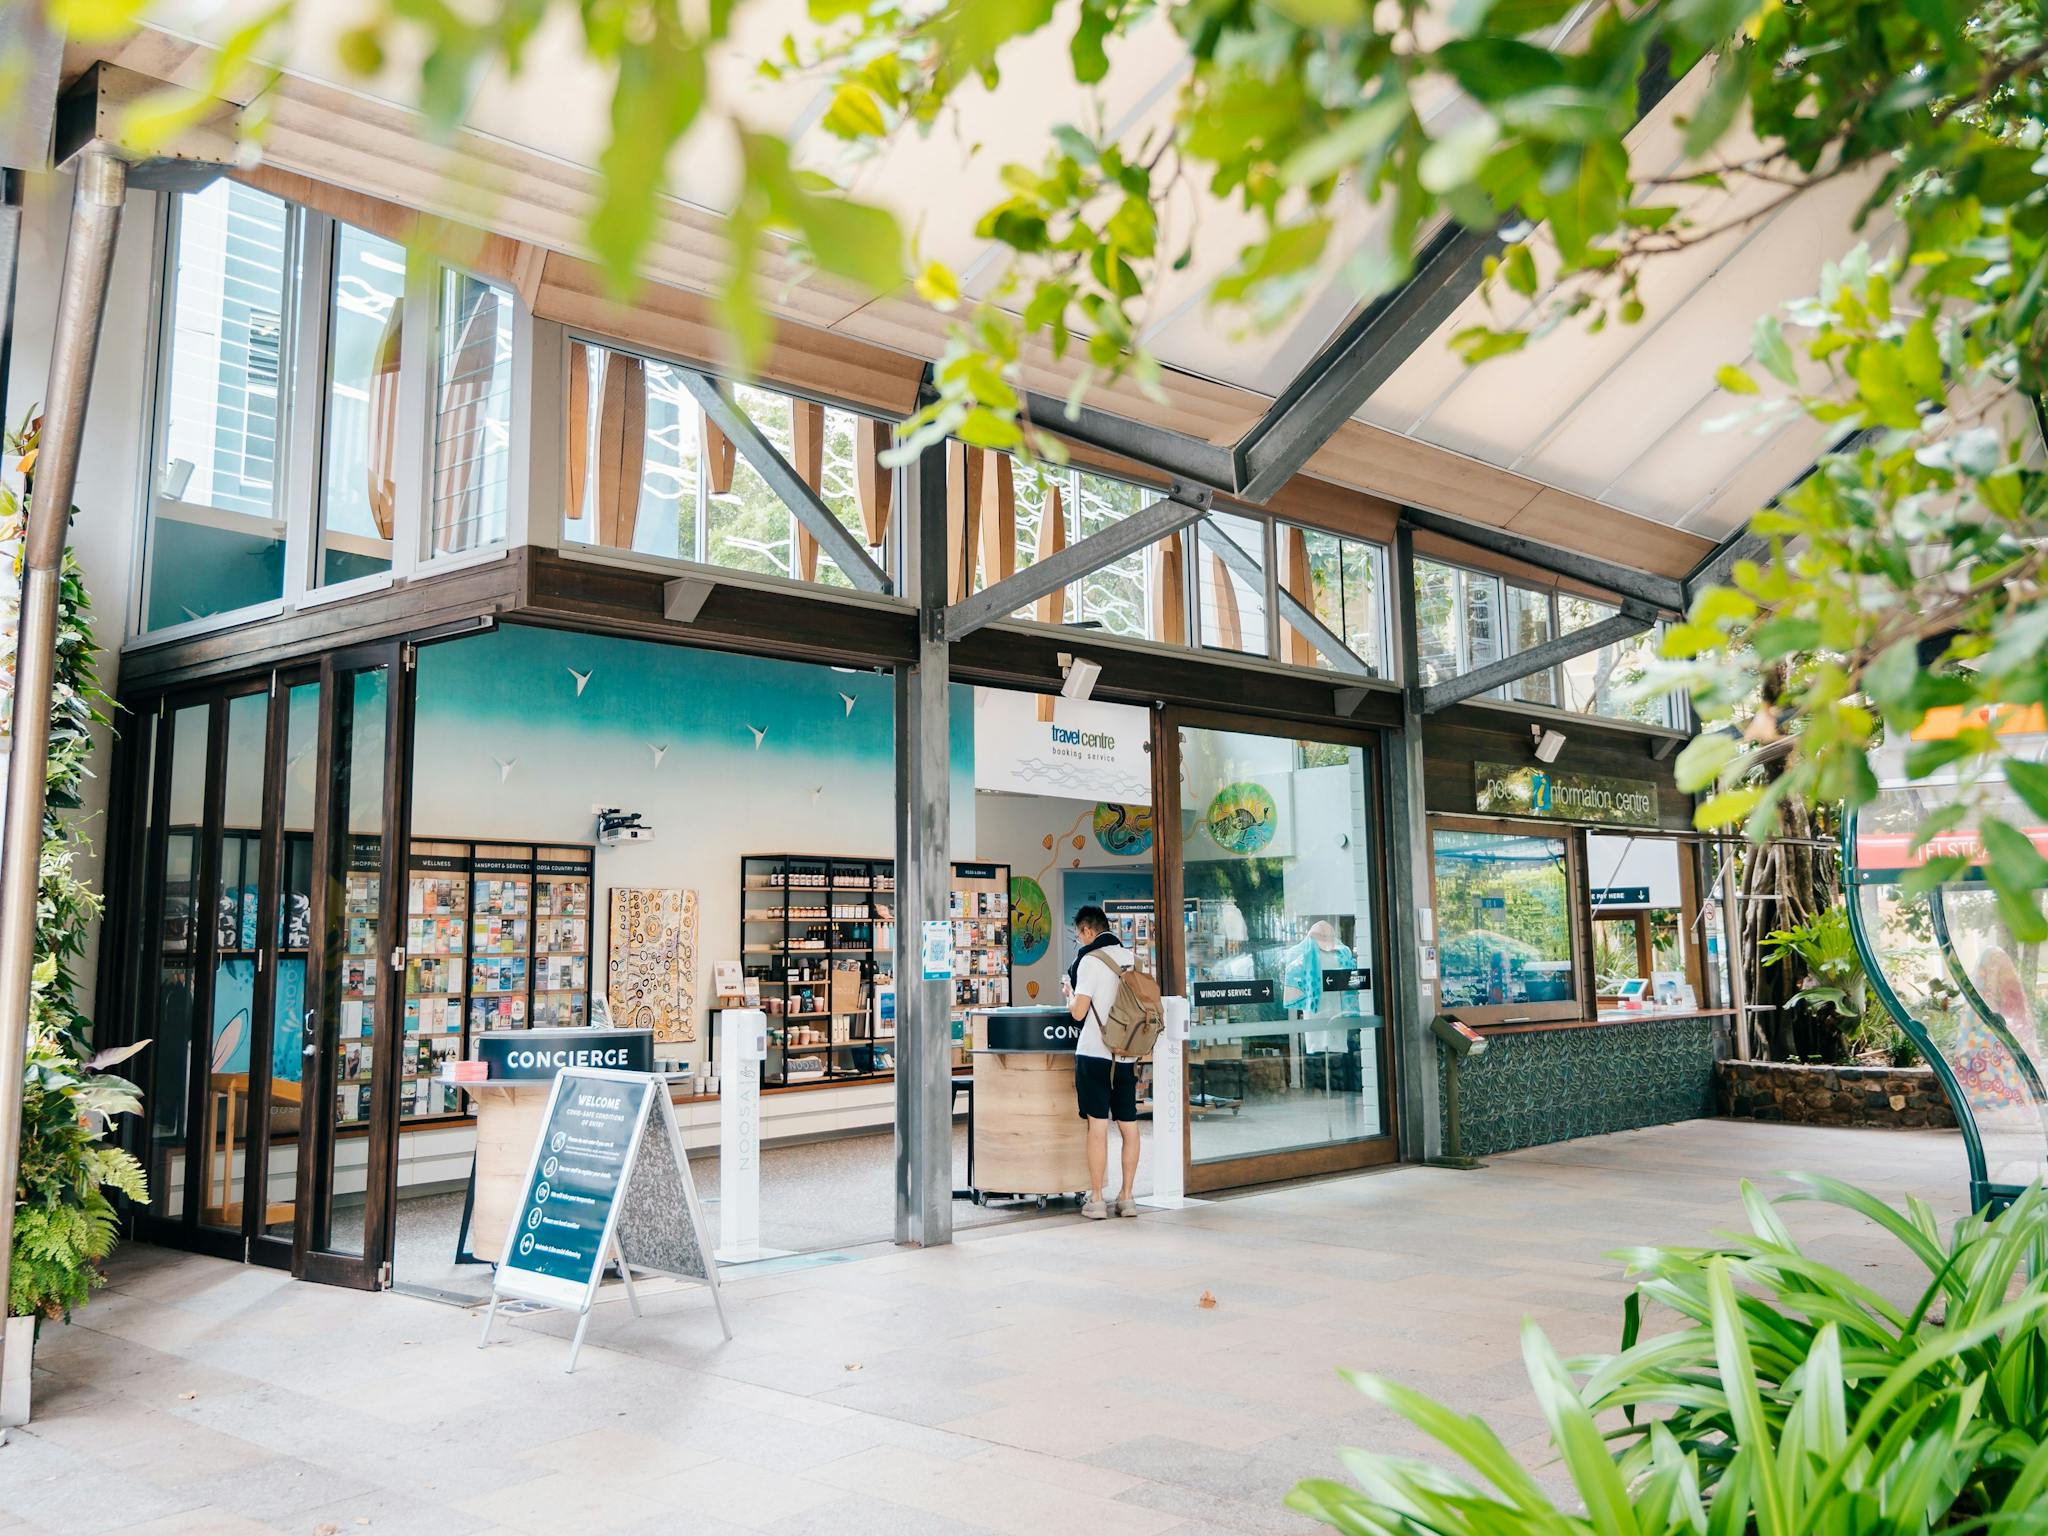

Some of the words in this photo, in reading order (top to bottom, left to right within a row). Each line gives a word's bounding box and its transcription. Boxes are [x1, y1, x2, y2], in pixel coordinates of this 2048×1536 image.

[1051, 724, 1080, 745] travel
[1081, 732, 1115, 750] centre
[1052, 747, 1082, 759] booking
[1087, 753, 1115, 762] service
[1487, 778, 1532, 801] noo
[1615, 791, 1650, 813] centre
[1199, 990, 1226, 998] WINDOW
[1227, 988, 1252, 997] SERVICE
[1043, 1025, 1082, 1040] CON
[507, 1048, 629, 1069] CONCIERGE
[578, 1094, 622, 1110] WELCOME
[1168, 1067, 1177, 1133] NOOSA
[739, 1089, 751, 1172] NOOSA
